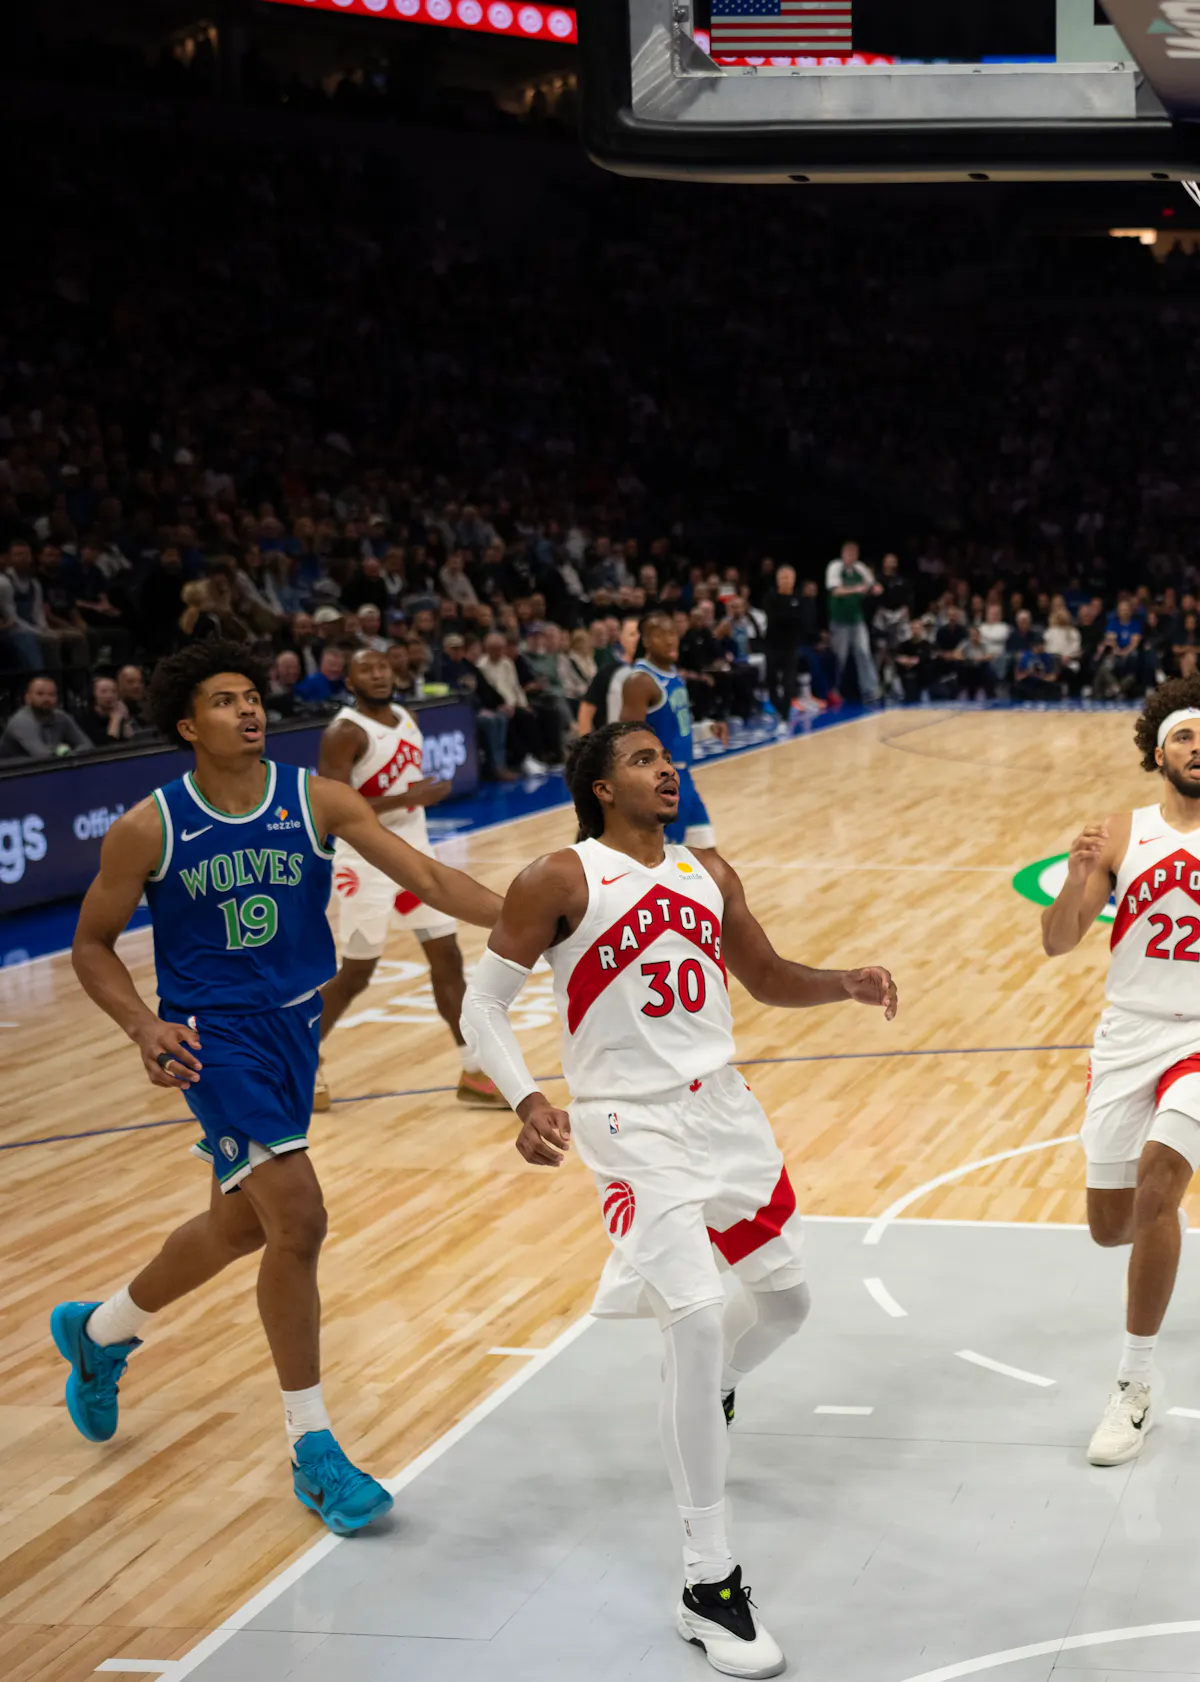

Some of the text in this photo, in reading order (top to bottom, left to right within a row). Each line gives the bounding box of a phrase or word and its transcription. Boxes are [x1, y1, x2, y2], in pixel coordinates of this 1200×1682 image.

[266, 820, 301, 831] sezzle
[178, 848, 304, 900] WOLVES
[217, 894, 278, 950] 19
[598, 898, 721, 970] RAPTORS
[641, 958, 706, 1018] 30
